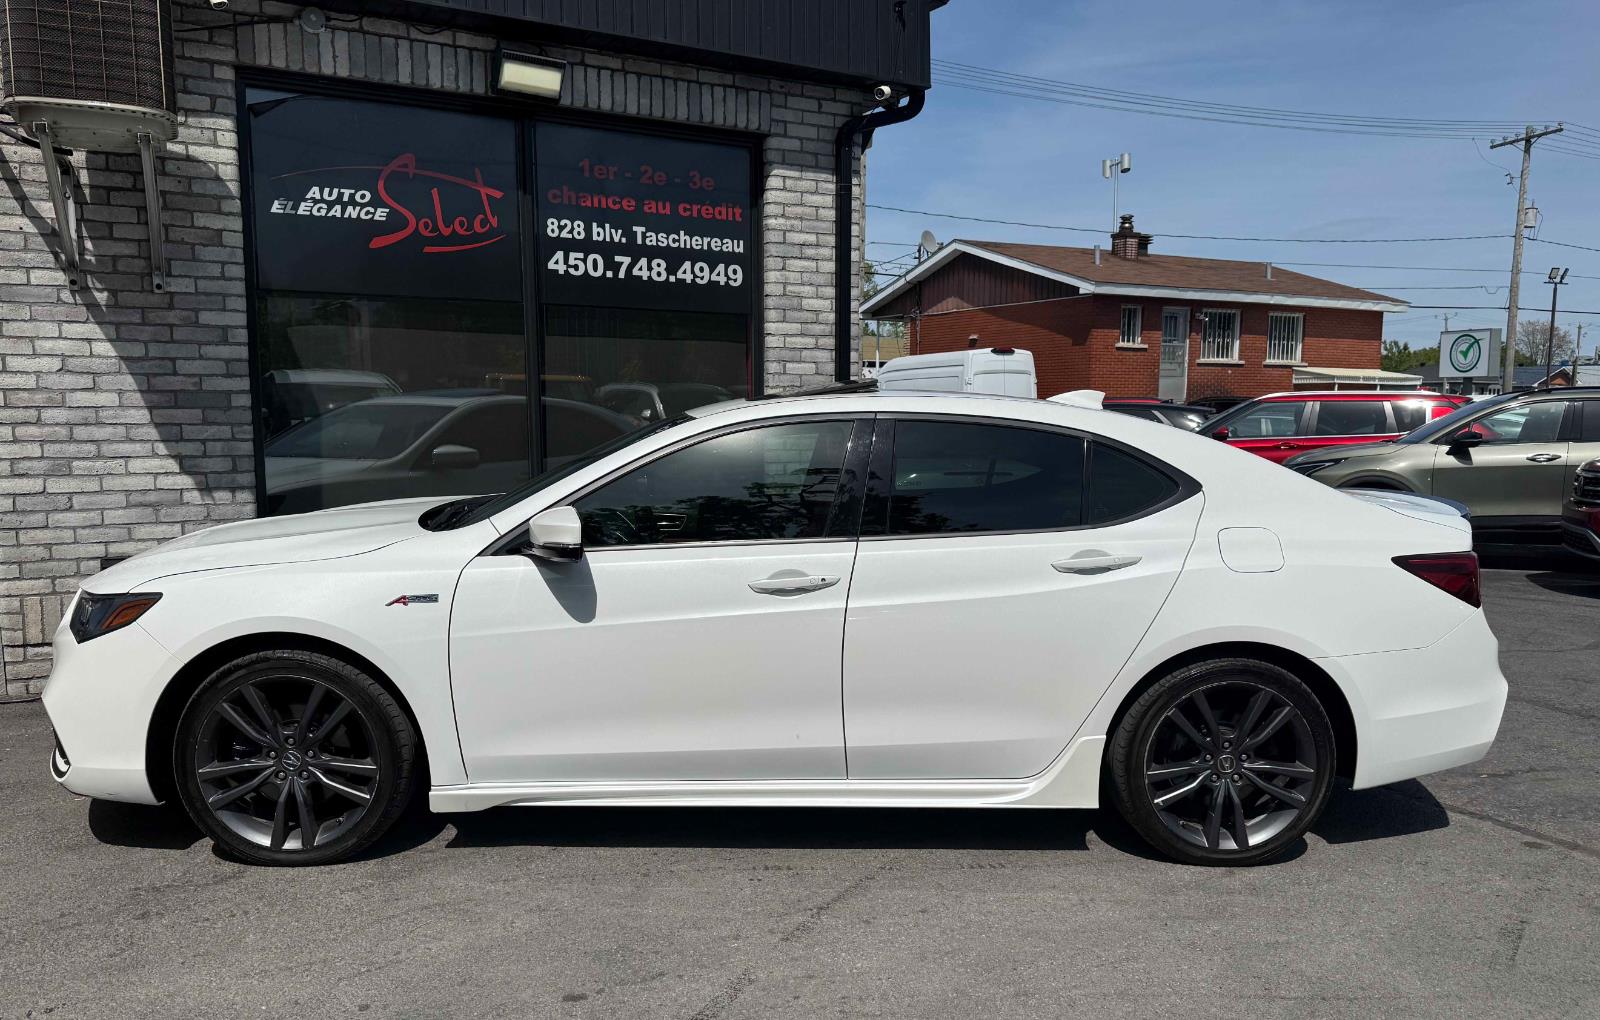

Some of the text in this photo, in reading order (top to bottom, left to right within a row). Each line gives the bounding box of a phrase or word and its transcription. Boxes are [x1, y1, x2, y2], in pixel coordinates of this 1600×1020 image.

[579, 158, 619, 180] 1er
[640, 164, 668, 186] 2e
[689, 170, 717, 191] 3e
[270, 197, 390, 221] ÉLÉGANCE
[305, 186, 372, 204] AUTO
[368, 152, 505, 249] Select
[546, 184, 743, 222] chance au crédit
[546, 217, 744, 253] 828 blv. Taschereau
[547, 250, 744, 287] 450.748.4949
